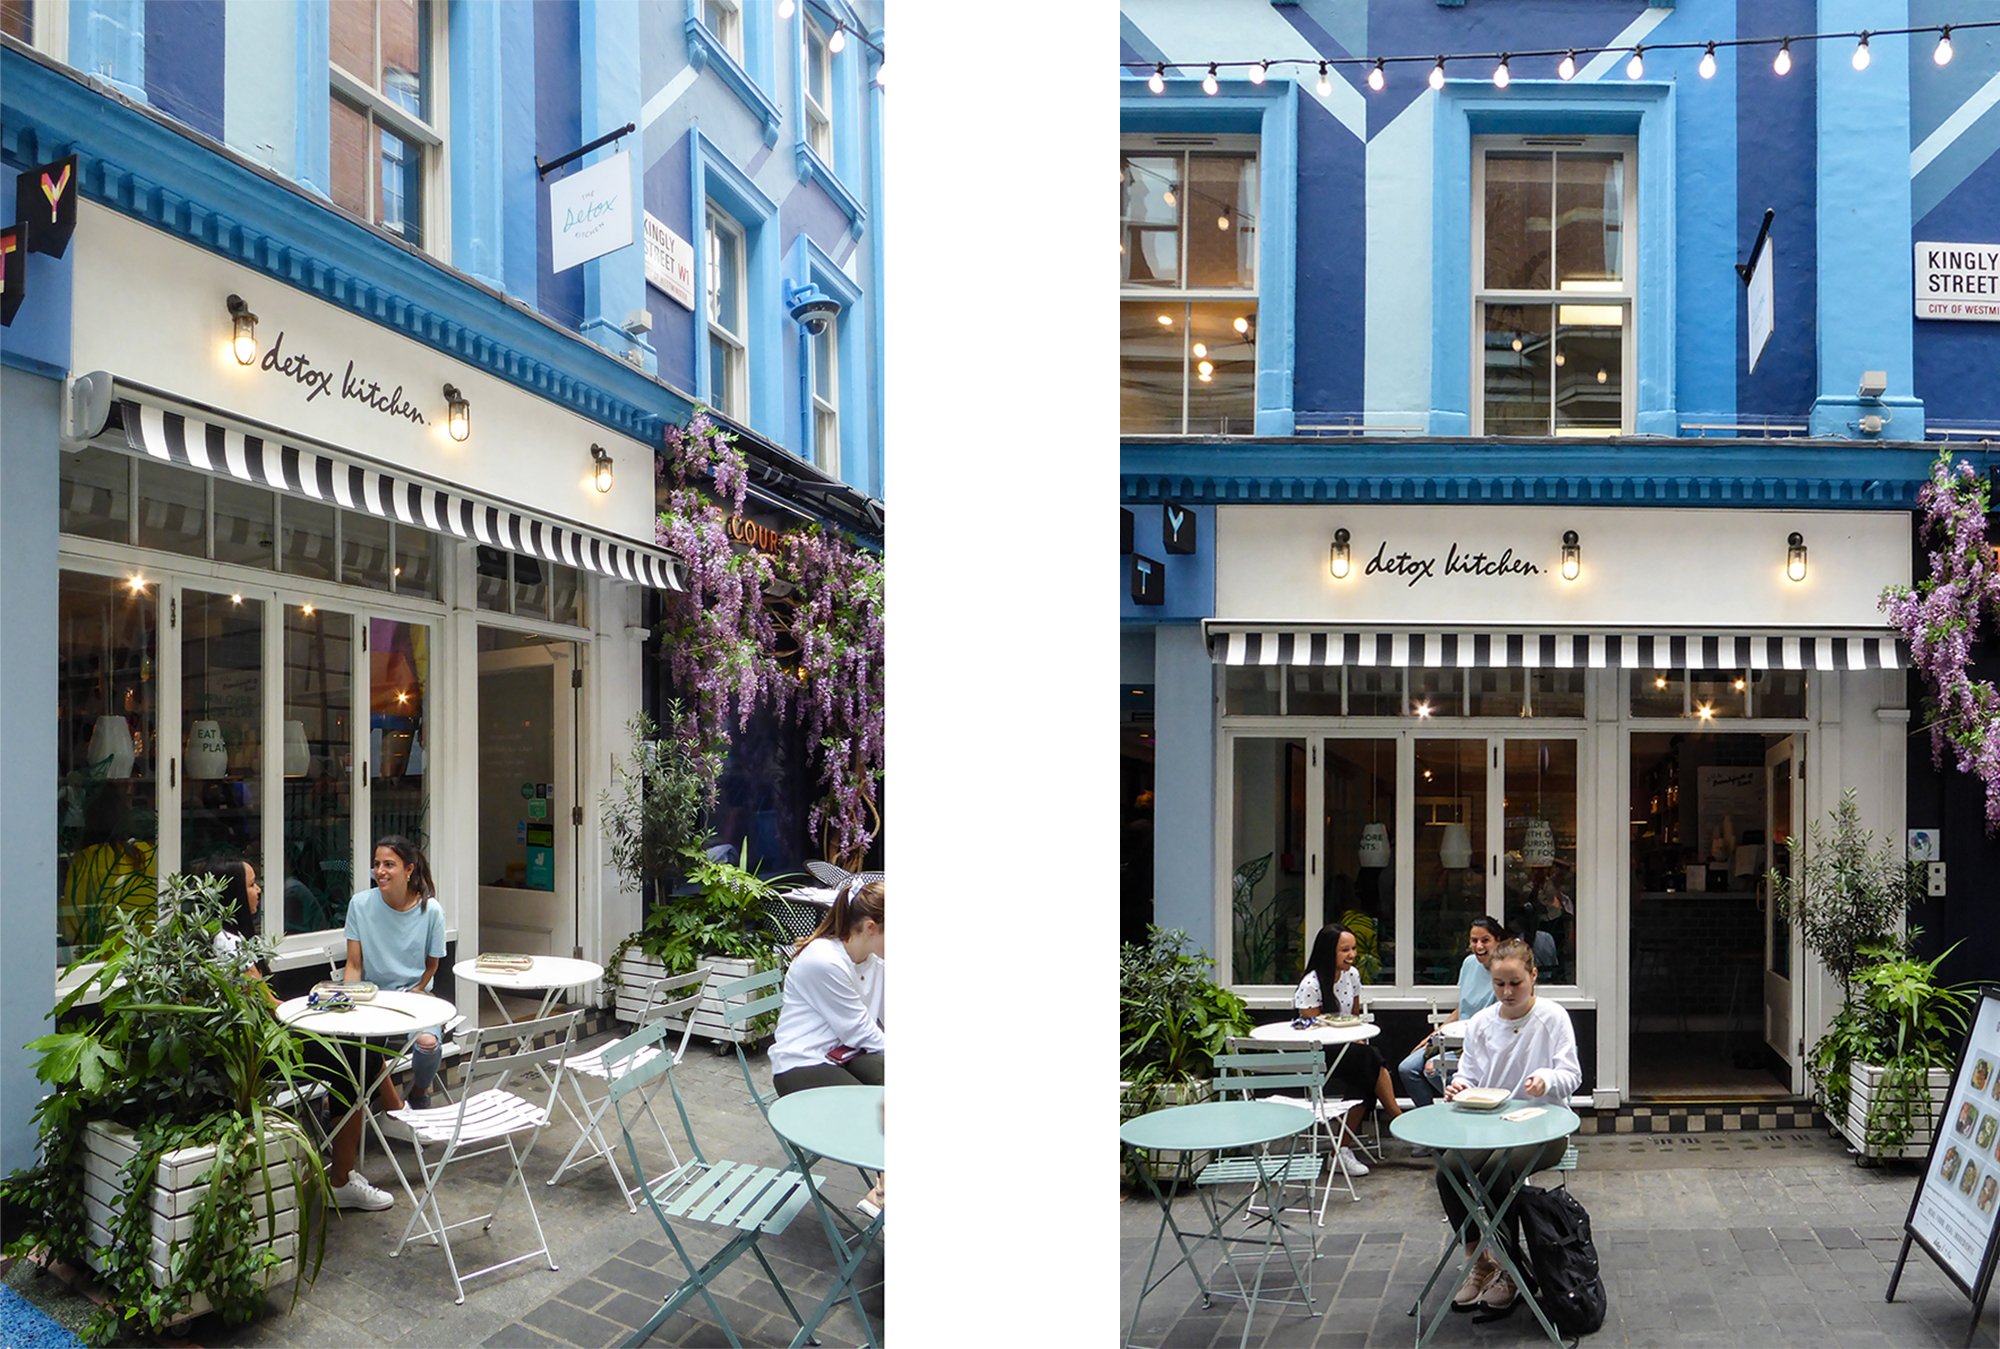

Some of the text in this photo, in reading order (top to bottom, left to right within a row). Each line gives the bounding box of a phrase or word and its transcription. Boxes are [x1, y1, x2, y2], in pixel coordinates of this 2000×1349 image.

[581, 190, 595, 200] THE
[563, 195, 618, 233] Detox
[574, 222, 605, 238] KITCHEN
[644, 218, 675, 253] KINGLY
[644, 238, 690, 286] STREET W1
[1928, 251, 1999, 271] KINGLY
[1928, 273, 1999, 294] STREET
[1928, 303, 2000, 315] CITY OF WESTMI
[261, 331, 334, 403] detox
[731, 514, 786, 556] COUR
[1364, 540, 1436, 588] detox
[197, 729, 216, 739] EAT
